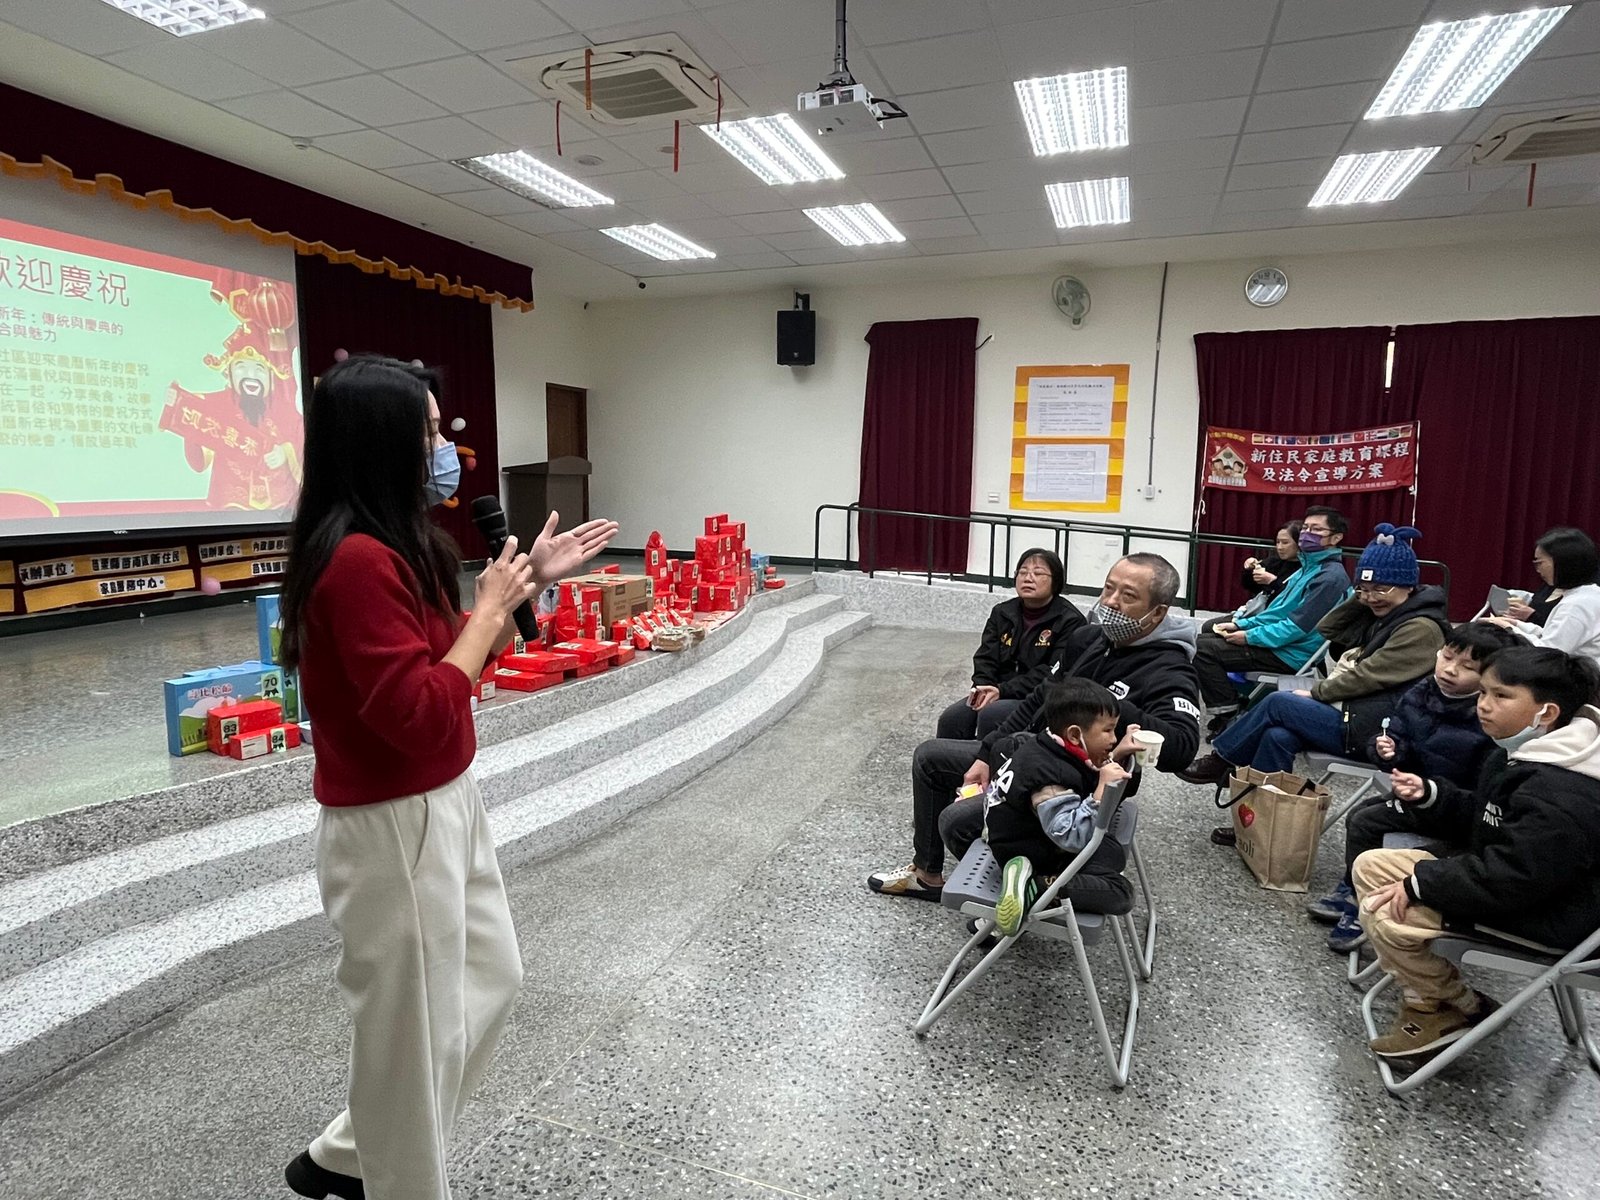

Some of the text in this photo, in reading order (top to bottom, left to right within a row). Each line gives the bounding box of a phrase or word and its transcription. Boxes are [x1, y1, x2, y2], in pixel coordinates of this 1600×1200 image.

[1250, 441, 1410, 464] 新住民家庭教育課程
[1262, 462, 1384, 483] 及法令宣導方案
[264, 676, 278, 688] 70
[223, 723, 237, 733] 83
[271, 734, 284, 744] 84
